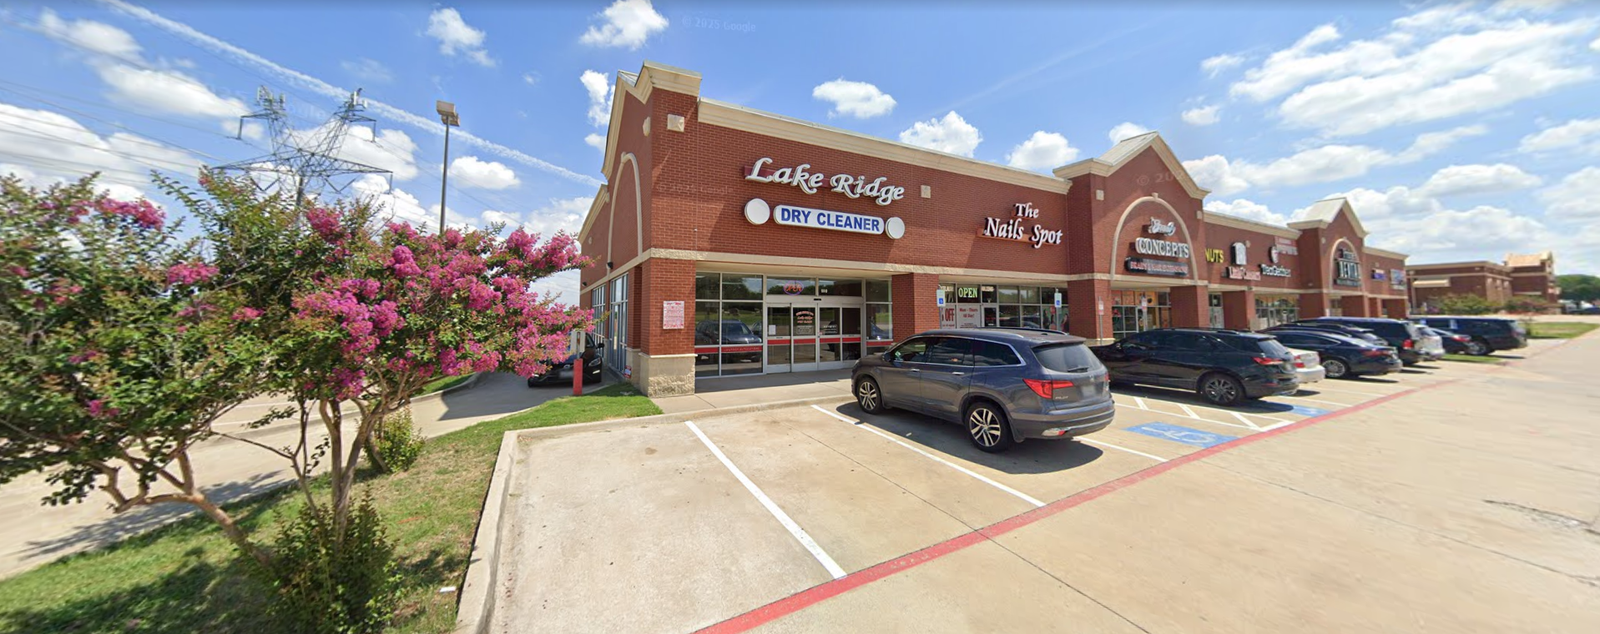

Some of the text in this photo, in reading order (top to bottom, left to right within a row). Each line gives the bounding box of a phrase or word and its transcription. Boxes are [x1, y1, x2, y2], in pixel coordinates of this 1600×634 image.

[745, 157, 905, 206] Lake Ridge
[781, 207, 880, 232] DRY CLEANER
[1014, 202, 1039, 218] The
[984, 216, 1063, 249] Nails Spot
[1135, 237, 1190, 258] CONCEPTS
[958, 286, 978, 298] OPEN
[944, 308, 955, 322] OFF
